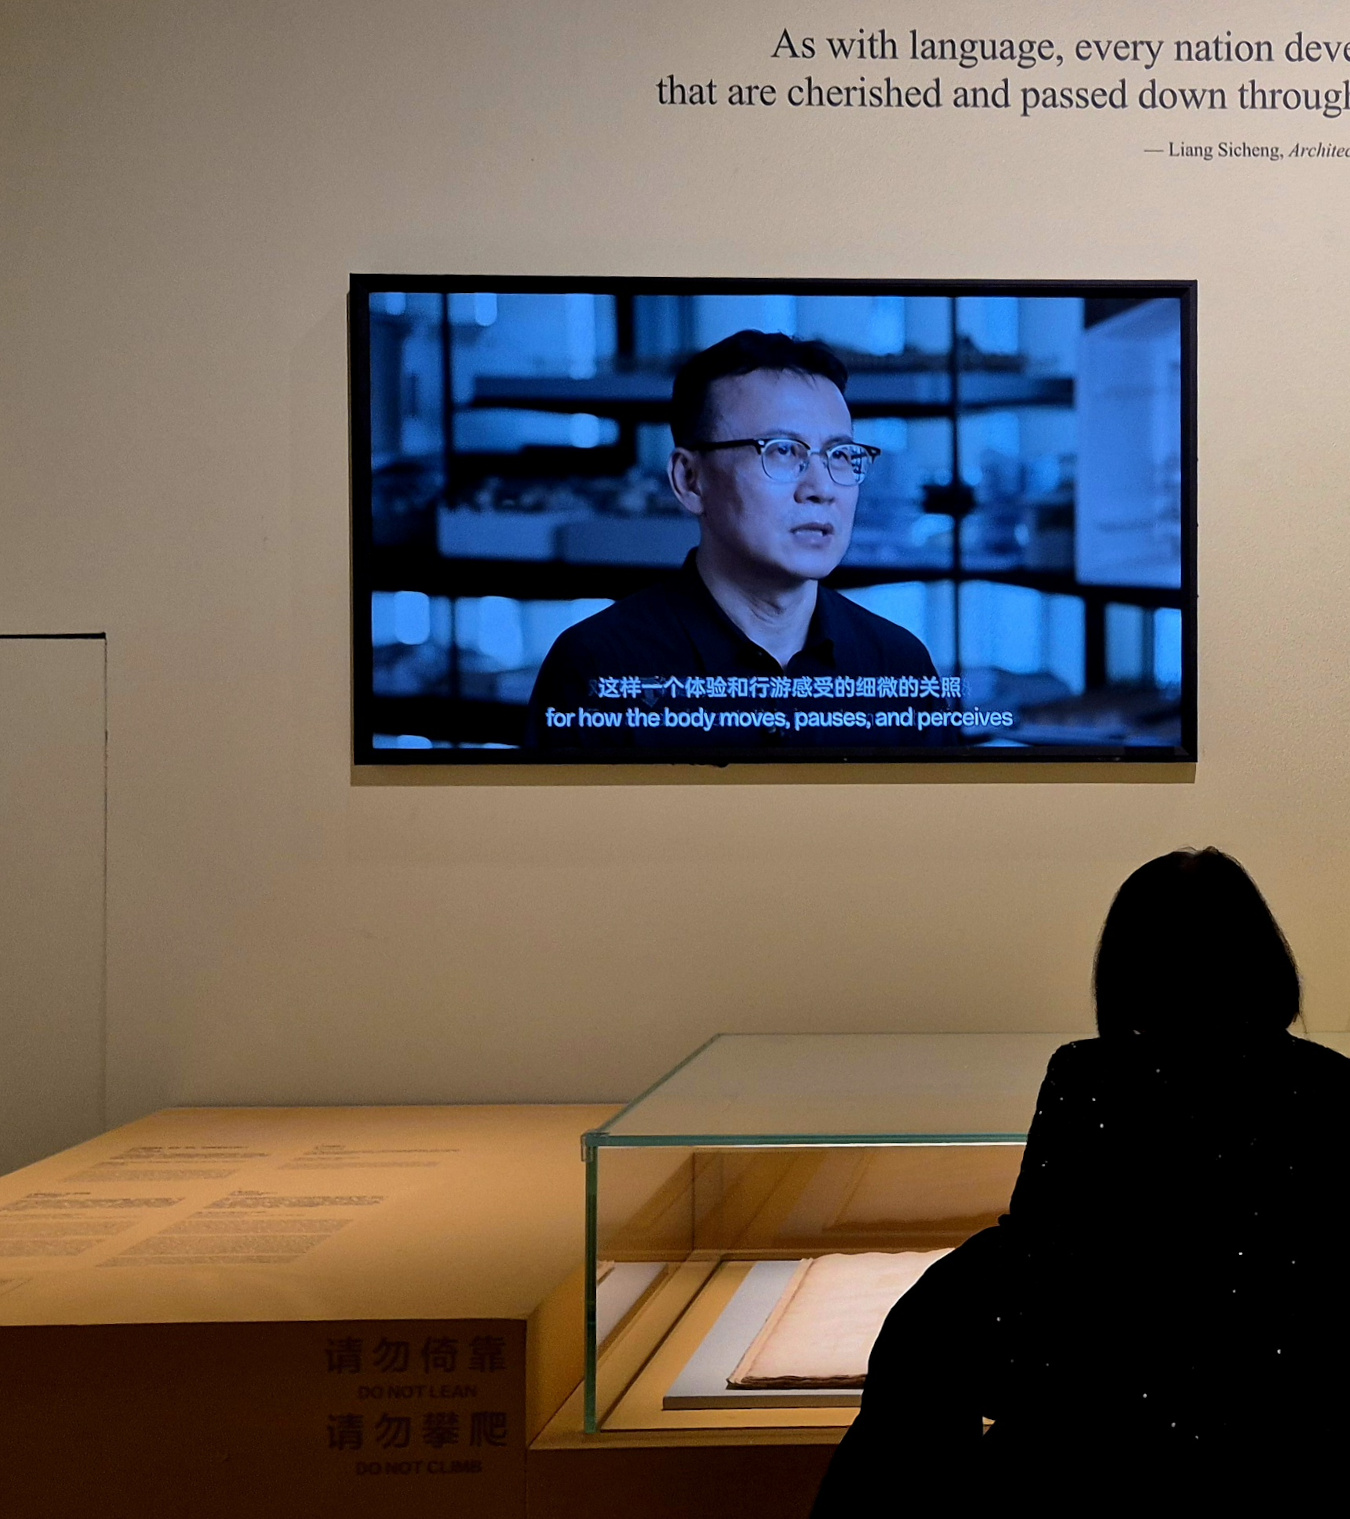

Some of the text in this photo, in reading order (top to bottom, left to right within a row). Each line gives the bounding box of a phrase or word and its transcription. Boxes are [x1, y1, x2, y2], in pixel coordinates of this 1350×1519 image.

[771, 28, 815, 58] As
[826, 28, 898, 59] with
[910, 29, 1063, 69] language,
[1076, 40, 1164, 69] every
[1174, 31, 1274, 62] nation
[656, 74, 717, 105] that
[728, 85, 776, 106] are
[788, 76, 942, 108] cherished
[954, 78, 1010, 108] and
[1021, 78, 1128, 116] passed
[1139, 79, 1226, 109] down
[1169, 142, 1213, 160] Liang
[1218, 142, 1284, 161] Sicheng,
[598, 675, 962, 700] 这样一个体验和行游感受的细微的关照
[546, 706, 1013, 731] for how the body moves, pauses, and perceives
[327, 1336, 506, 1374] 请勿倚靠
[358, 1385, 477, 1399] DO NOT LEAN
[327, 1412, 507, 1450] 请勿攀爬
[356, 1460, 483, 1476] DO NOT CLIMB
